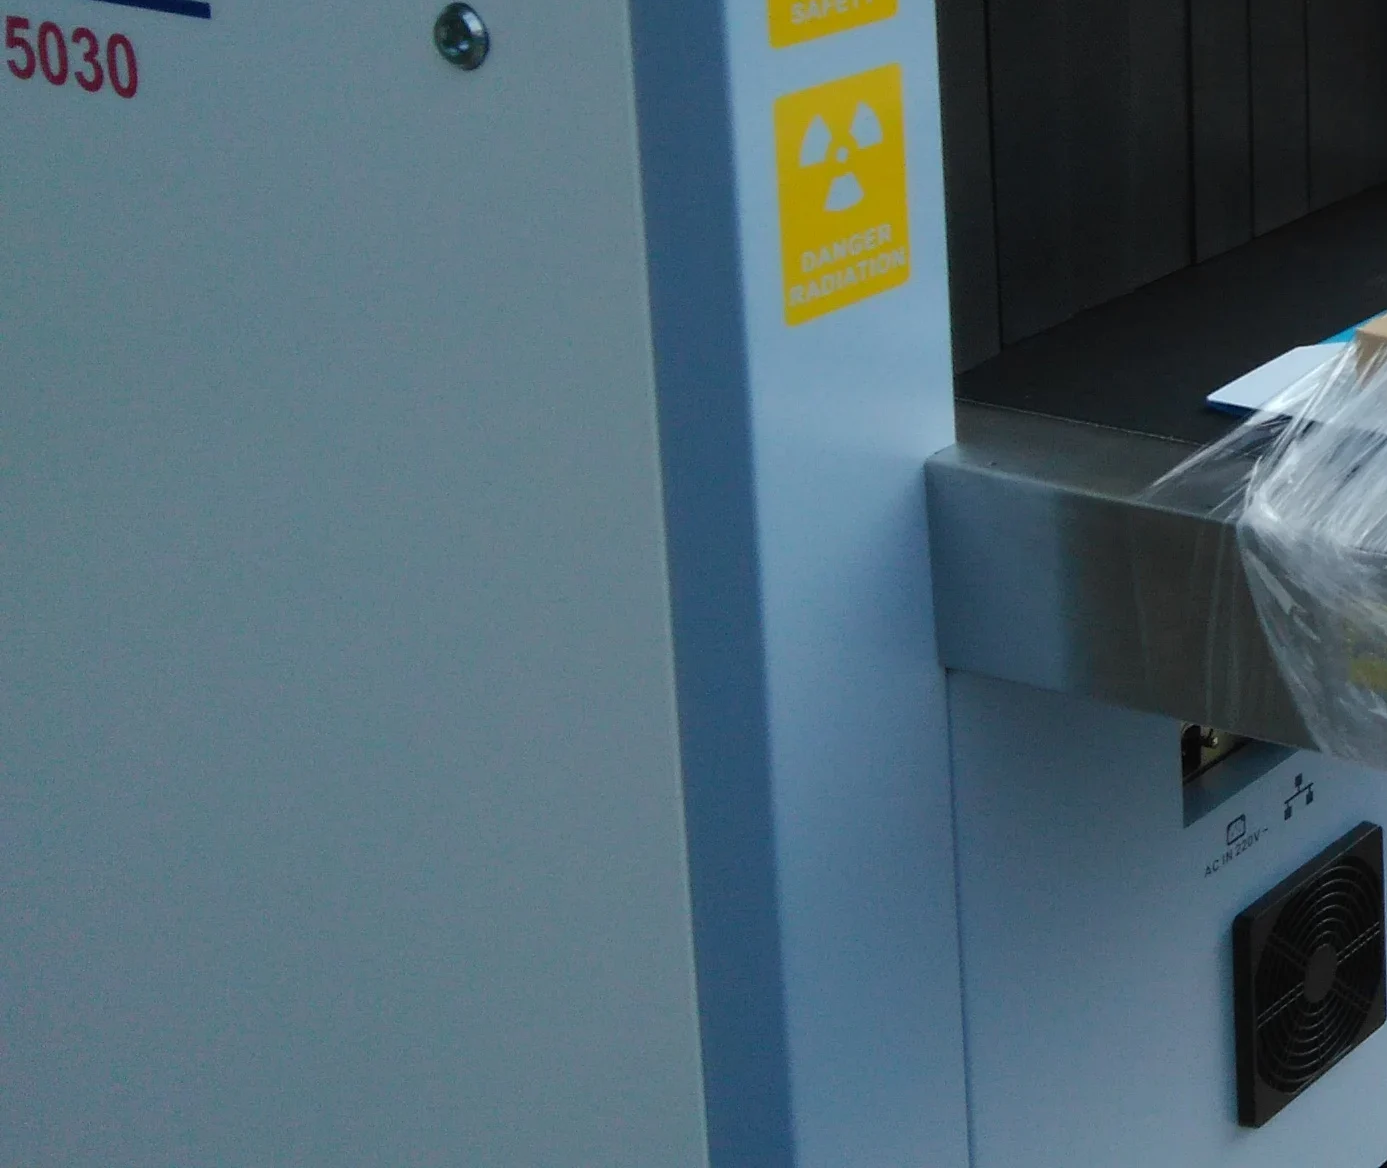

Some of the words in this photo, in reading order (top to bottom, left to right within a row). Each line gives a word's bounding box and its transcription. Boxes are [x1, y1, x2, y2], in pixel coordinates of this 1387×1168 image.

[6, 15, 138, 99] 5030
[788, 246, 906, 307] RADIATION
[801, 222, 892, 273] DANGER
